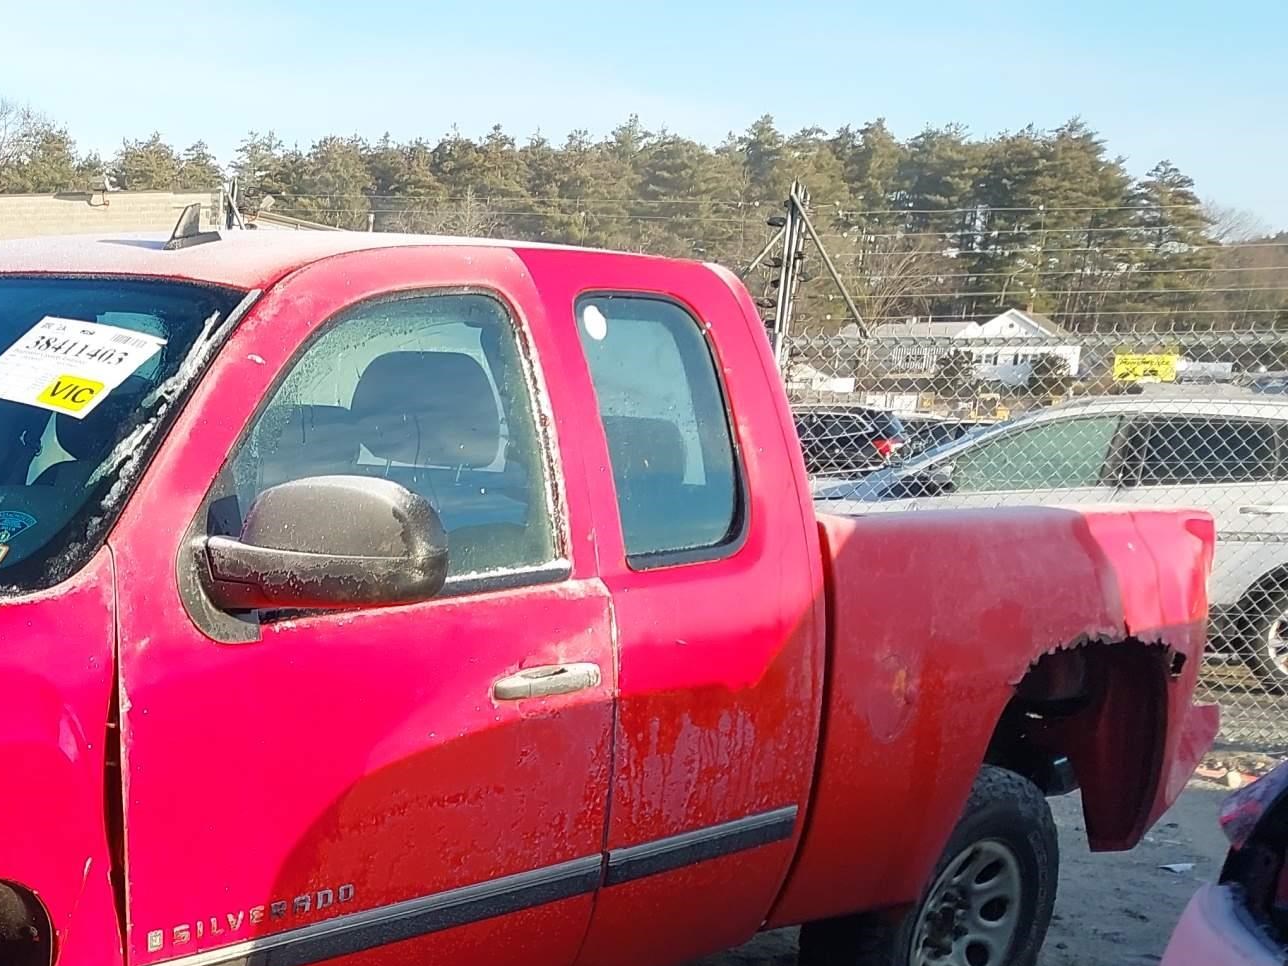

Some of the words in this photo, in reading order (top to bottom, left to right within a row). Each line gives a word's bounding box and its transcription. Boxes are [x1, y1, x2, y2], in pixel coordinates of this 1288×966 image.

[26, 335, 129, 366] 38411403
[50, 380, 95, 404] VIC
[172, 883, 356, 945] SILVERADO
